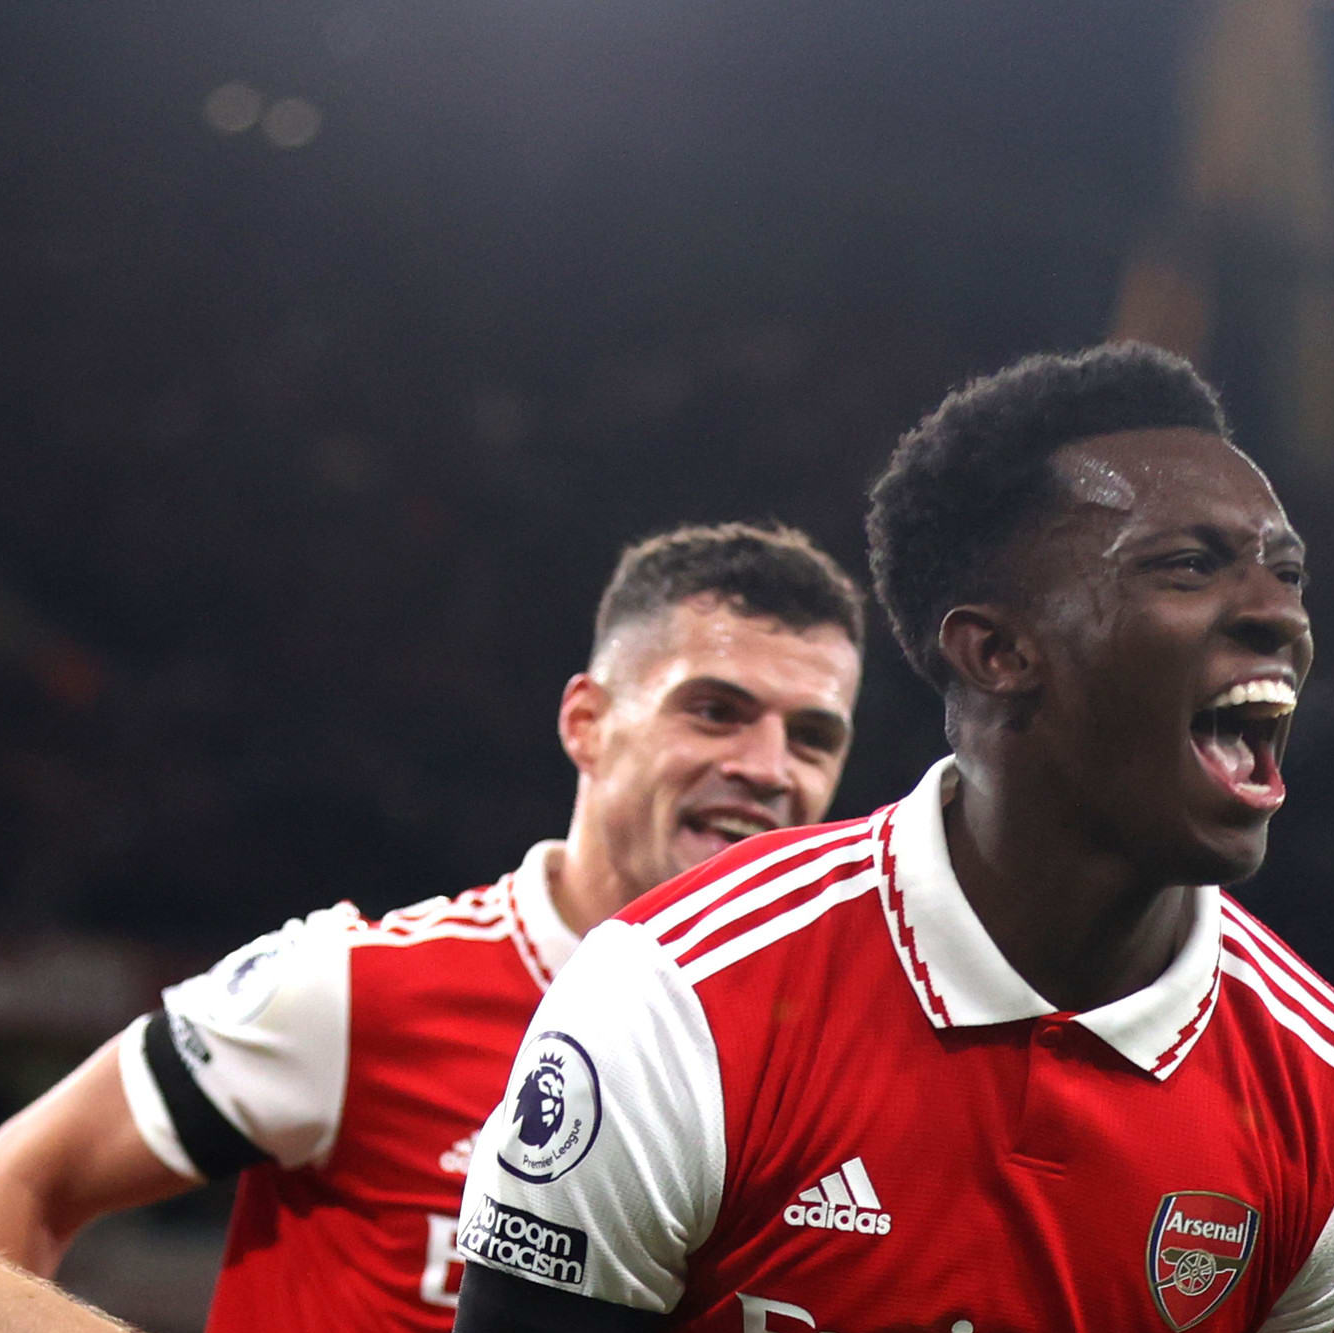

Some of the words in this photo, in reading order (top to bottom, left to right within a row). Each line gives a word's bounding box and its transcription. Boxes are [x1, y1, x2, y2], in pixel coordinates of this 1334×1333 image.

[523, 1154, 553, 1169] Premier
[552, 1118, 582, 1160] League
[495, 1211, 571, 1257] room
[783, 1201, 892, 1236] adidas
[1166, 1211, 1245, 1244] Arsenal
[487, 1236, 583, 1284] racism
